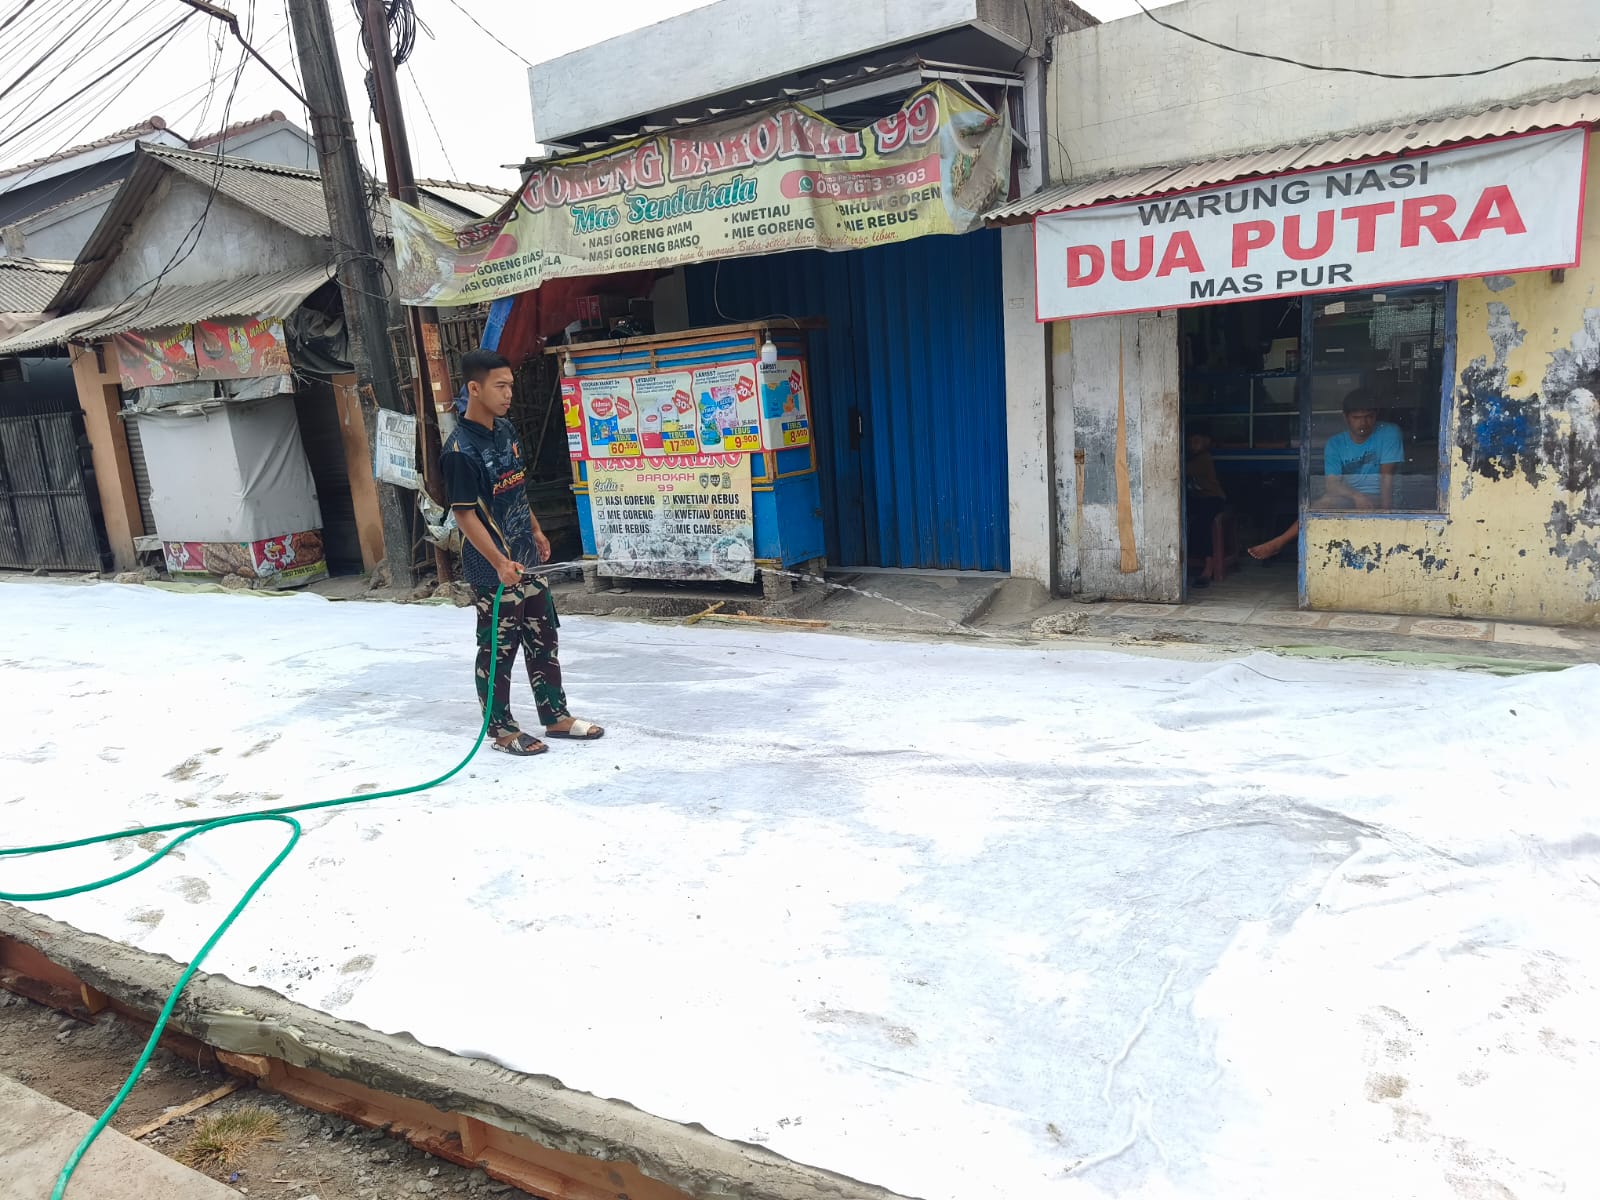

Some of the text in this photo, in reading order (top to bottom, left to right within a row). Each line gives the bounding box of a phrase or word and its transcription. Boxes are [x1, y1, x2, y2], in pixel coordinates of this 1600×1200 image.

[874, 93, 940, 154] 99
[1138, 160, 1429, 226] WARUNG NASI
[571, 173, 757, 235] Mas Sendakala
[839, 199, 883, 216] BIHUN
[731, 204, 790, 224] KWETIAU
[845, 209, 918, 232] MIE REBUS
[589, 221, 693, 248] NASI GORENG AYAM
[732, 218, 815, 239] MIE GORENG
[1067, 185, 1527, 288] DUA PUTRA
[589, 235, 700, 262] NASI GORENG BAKSO
[477, 258, 521, 276] GORENG
[482, 271, 522, 288] GORENG
[524, 267, 537, 279] ATI
[1190, 263, 1353, 300] MAS PUR
[593, 453, 742, 472] NASI GORENG
[637, 473, 695, 482] BAROKAH
[658, 484, 674, 492] 99
[606, 495, 655, 505] NASI GORENG
[672, 494, 739, 505] KWETIAU REBUS
[607, 510, 653, 519] MIE GORENG
[675, 509, 746, 519] KWETIAU GORENG
[609, 524, 649, 534] MIE REBUS
[676, 525, 691, 534] MIE
